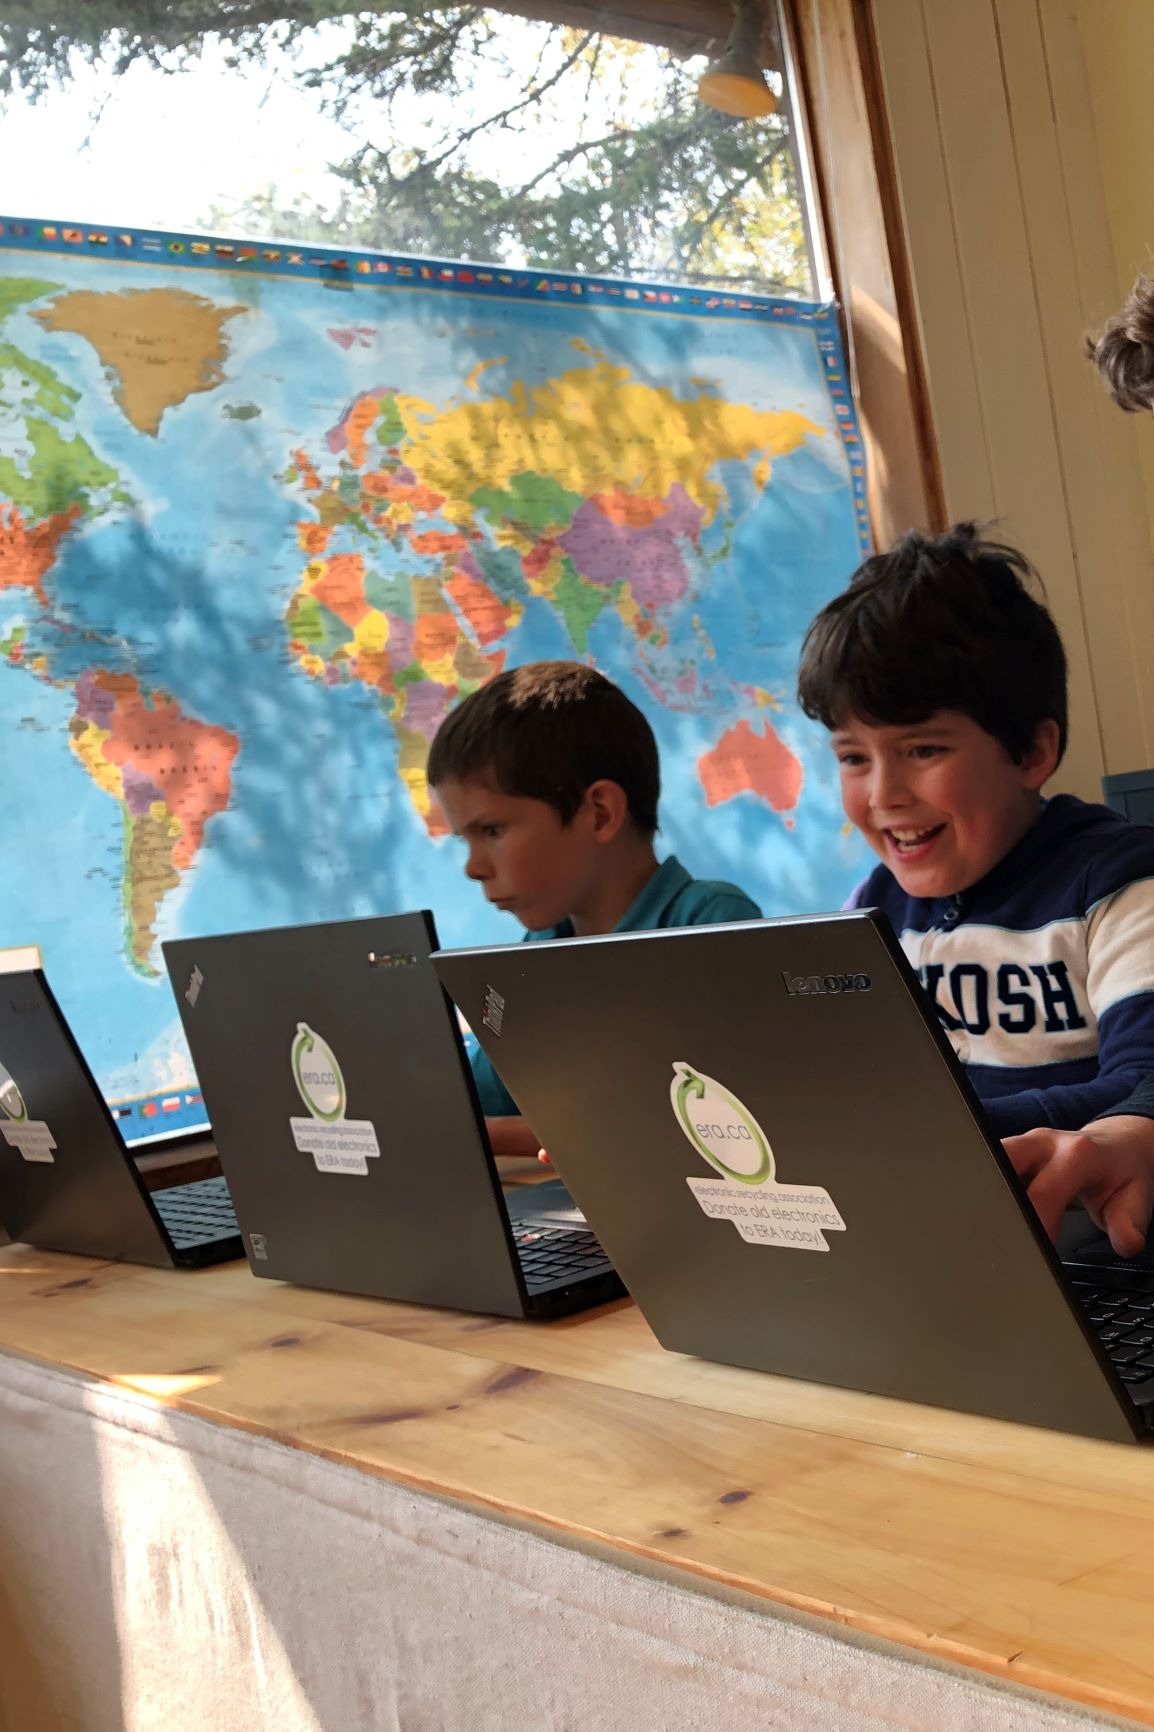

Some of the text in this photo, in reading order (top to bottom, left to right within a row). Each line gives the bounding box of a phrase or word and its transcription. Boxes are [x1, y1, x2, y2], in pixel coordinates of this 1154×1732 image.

[696, 1123, 753, 1141] era.ca
[702, 1200, 841, 1226] Donate old electronics
[740, 1222, 754, 1236] to
[754, 1225, 780, 1238] ERA
